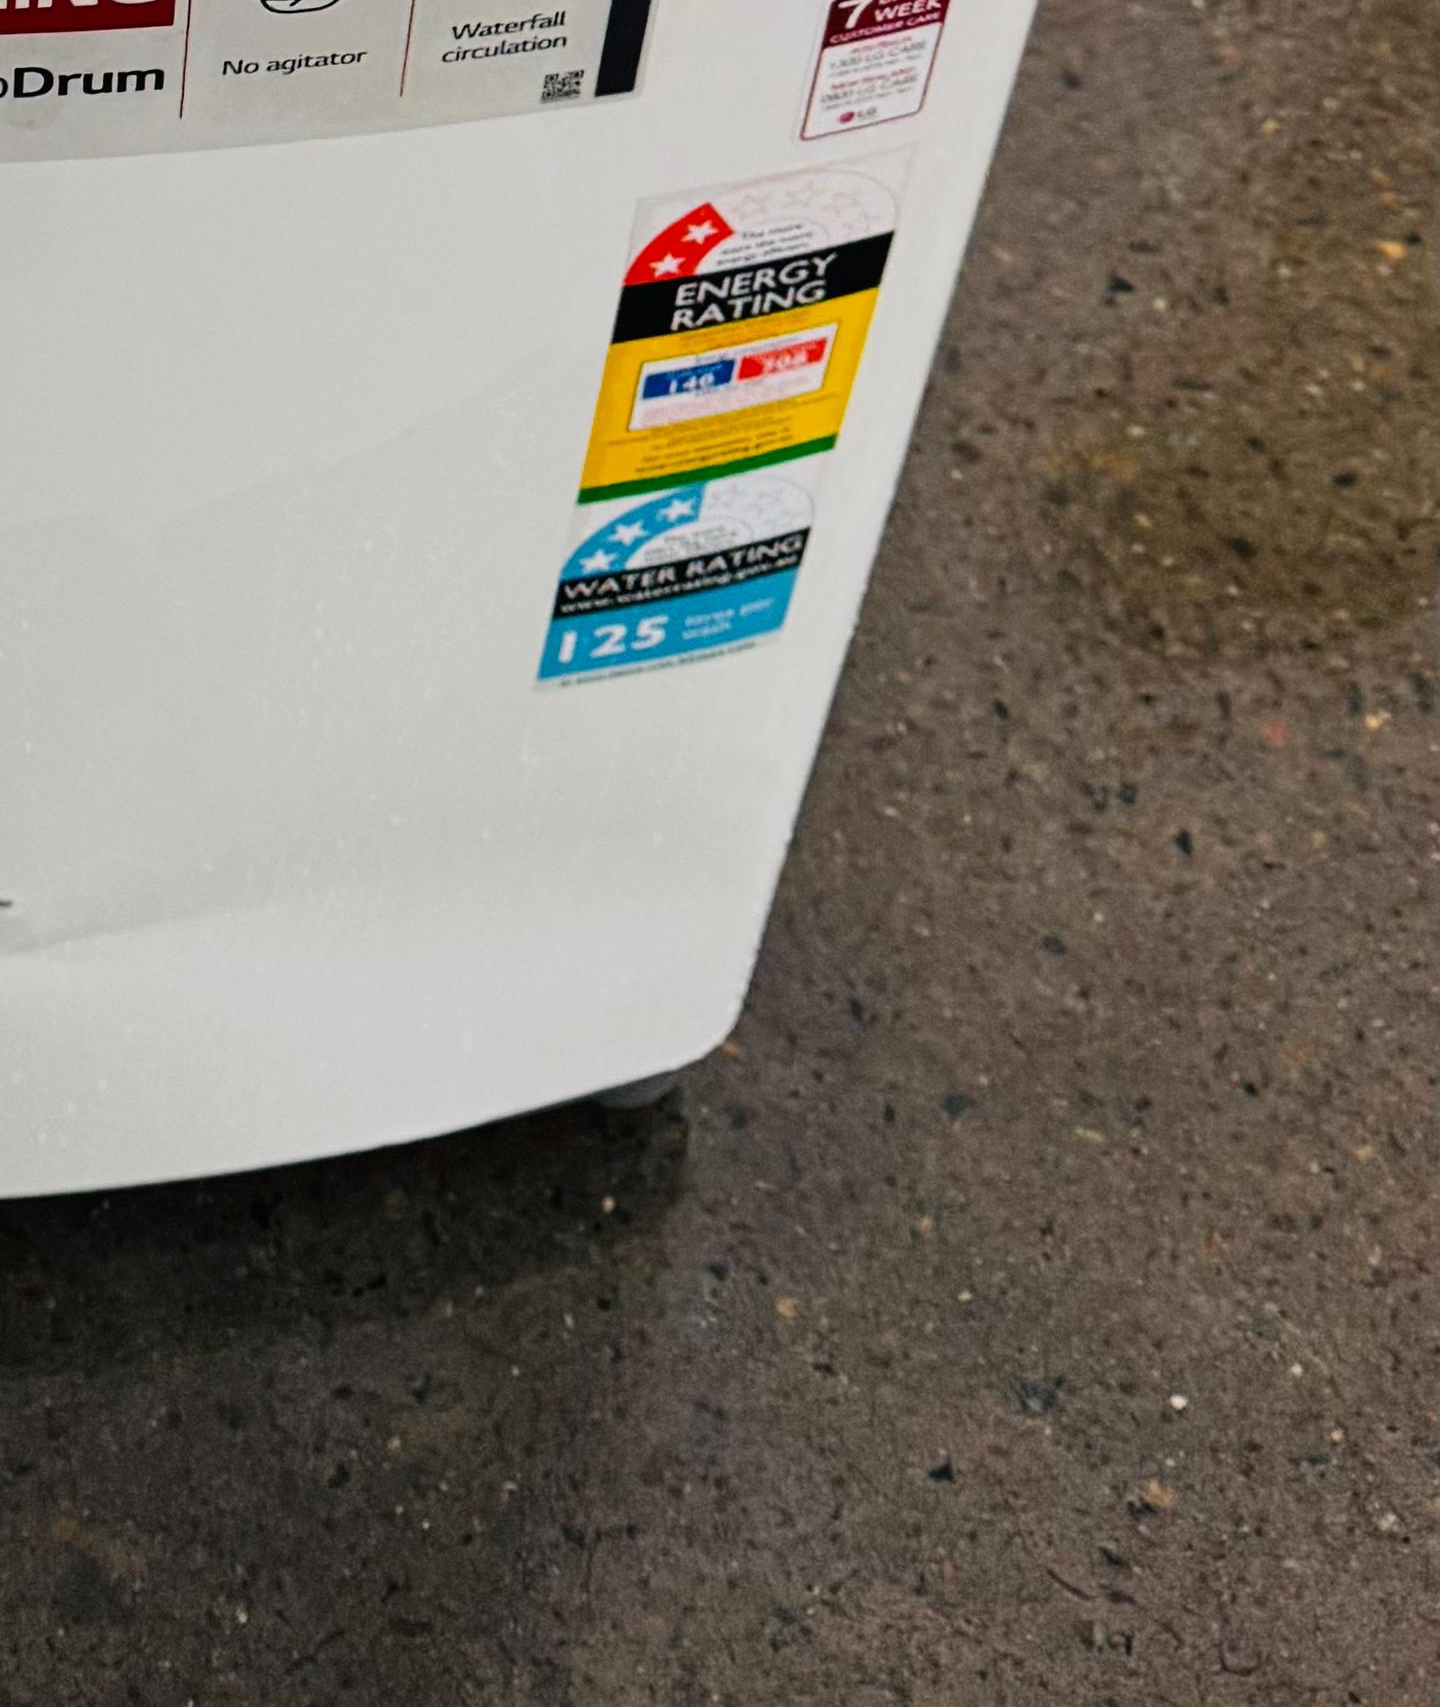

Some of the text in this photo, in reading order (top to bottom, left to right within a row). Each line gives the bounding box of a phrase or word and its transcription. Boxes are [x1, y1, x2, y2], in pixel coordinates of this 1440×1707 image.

[441, 32, 567, 64] circulation
[451, 10, 566, 41] Waterfall
[222, 48, 368, 76] No agitator
[674, 251, 839, 307] ENERGY
[670, 280, 827, 332] RATING
[563, 566, 676, 600] WATER
[685, 536, 803, 578] RATING
[558, 614, 670, 664] 125
